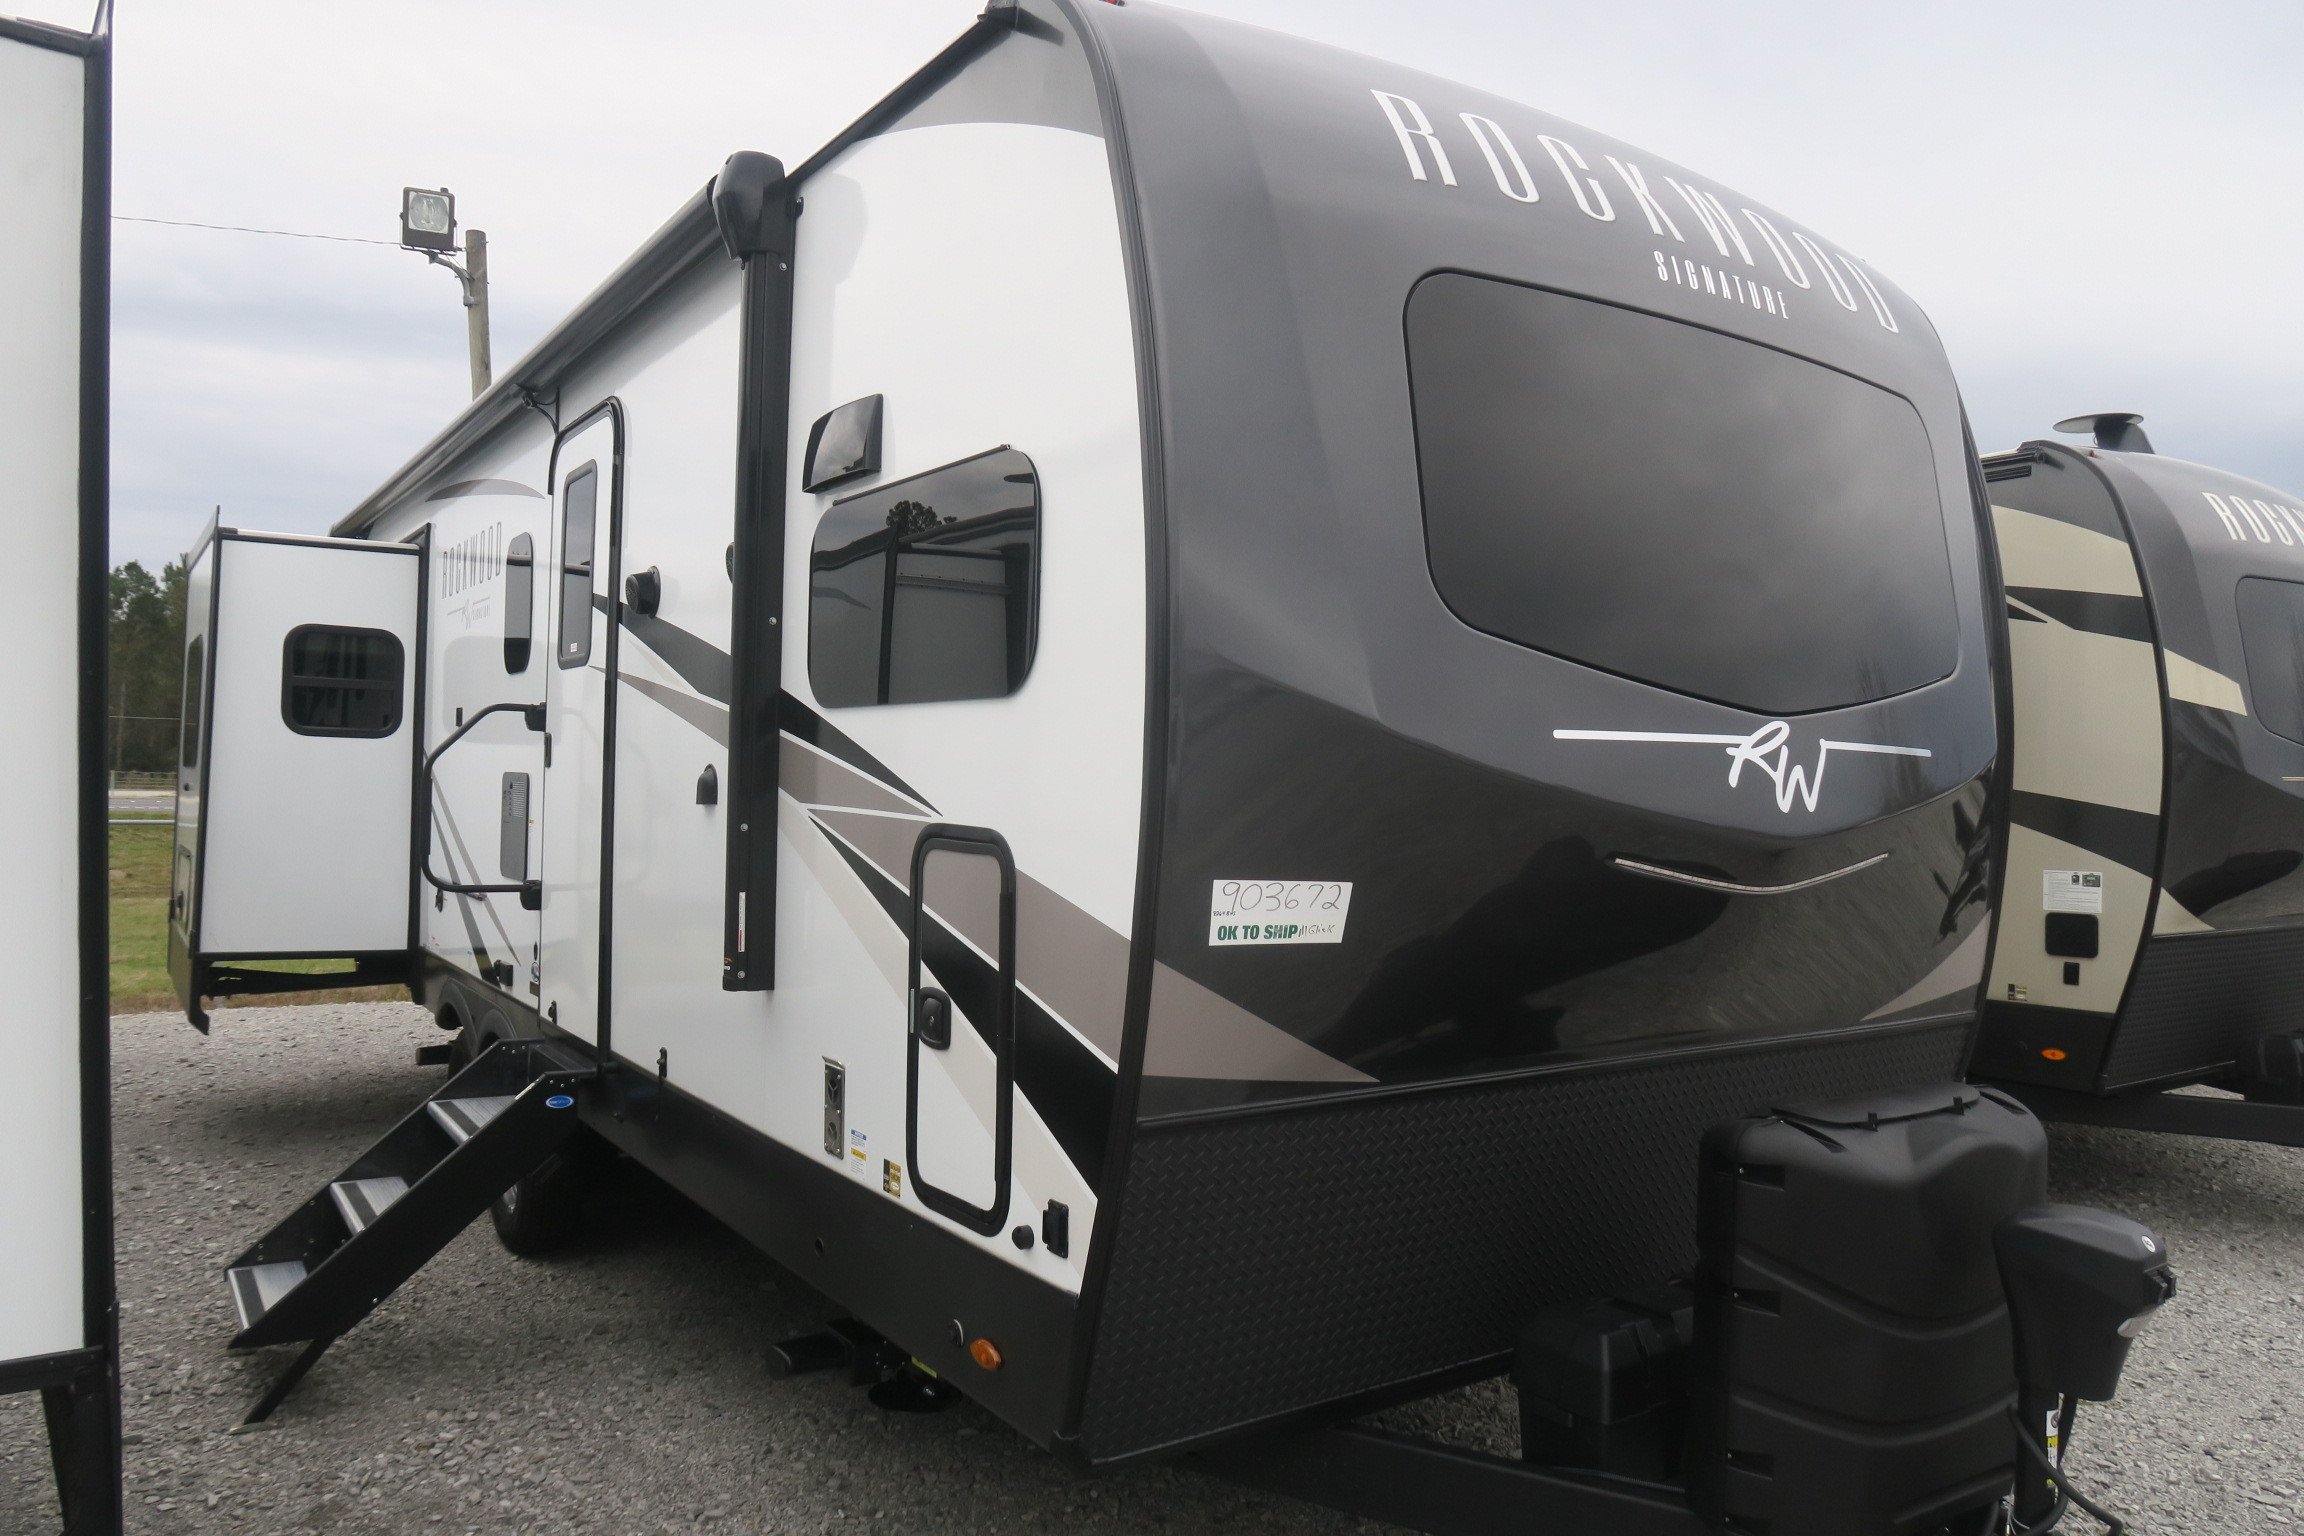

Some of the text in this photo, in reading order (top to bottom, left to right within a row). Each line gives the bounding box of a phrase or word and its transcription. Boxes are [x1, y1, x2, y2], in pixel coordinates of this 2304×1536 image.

[1369, 89, 1899, 333] ROCKWOOD
[1653, 250, 1789, 319] SIGNATURE
[2202, 492, 2304, 546] ROCK
[442, 521, 501, 599] ROCKWOOD
[1726, 720, 1826, 813] RW
[1223, 881, 1342, 912] 903672
[1217, 925, 1239, 941] OK
[1242, 925, 1260, 940] TO
[1264, 924, 1298, 940] SHIP
